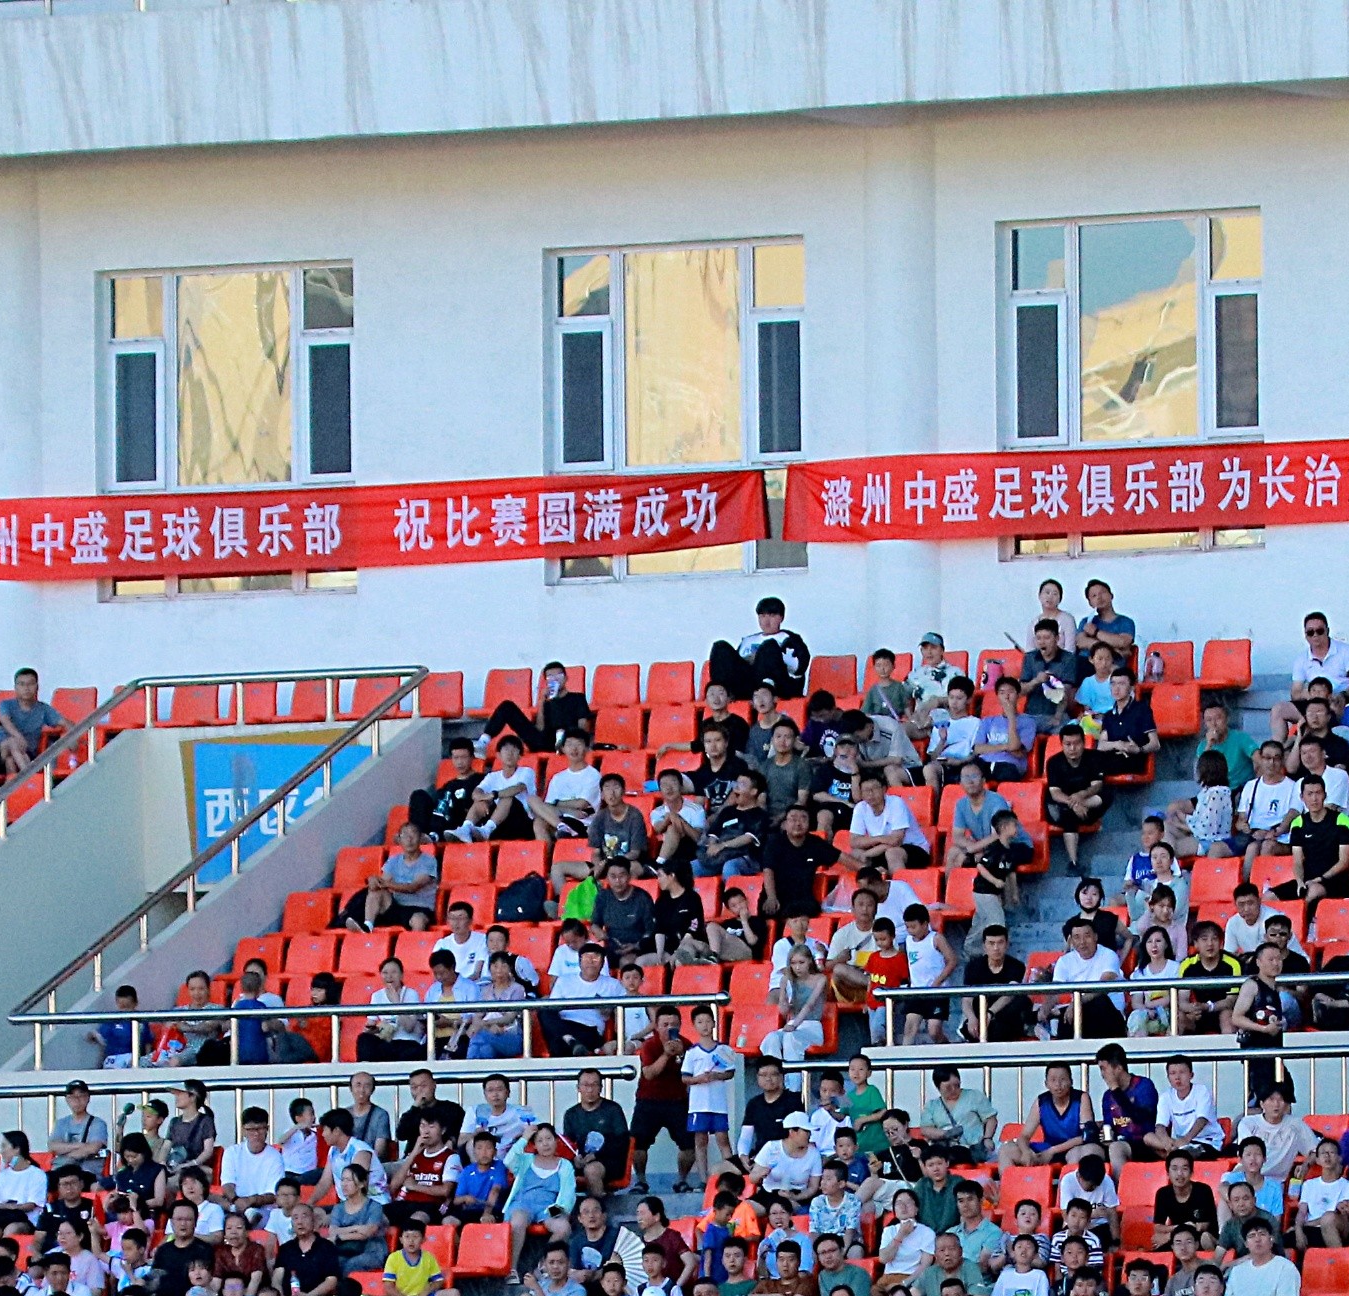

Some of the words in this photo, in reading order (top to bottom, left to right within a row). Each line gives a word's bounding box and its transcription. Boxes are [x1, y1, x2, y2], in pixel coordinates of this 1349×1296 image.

[393, 481, 720, 552] 祝比赛圆满成功
